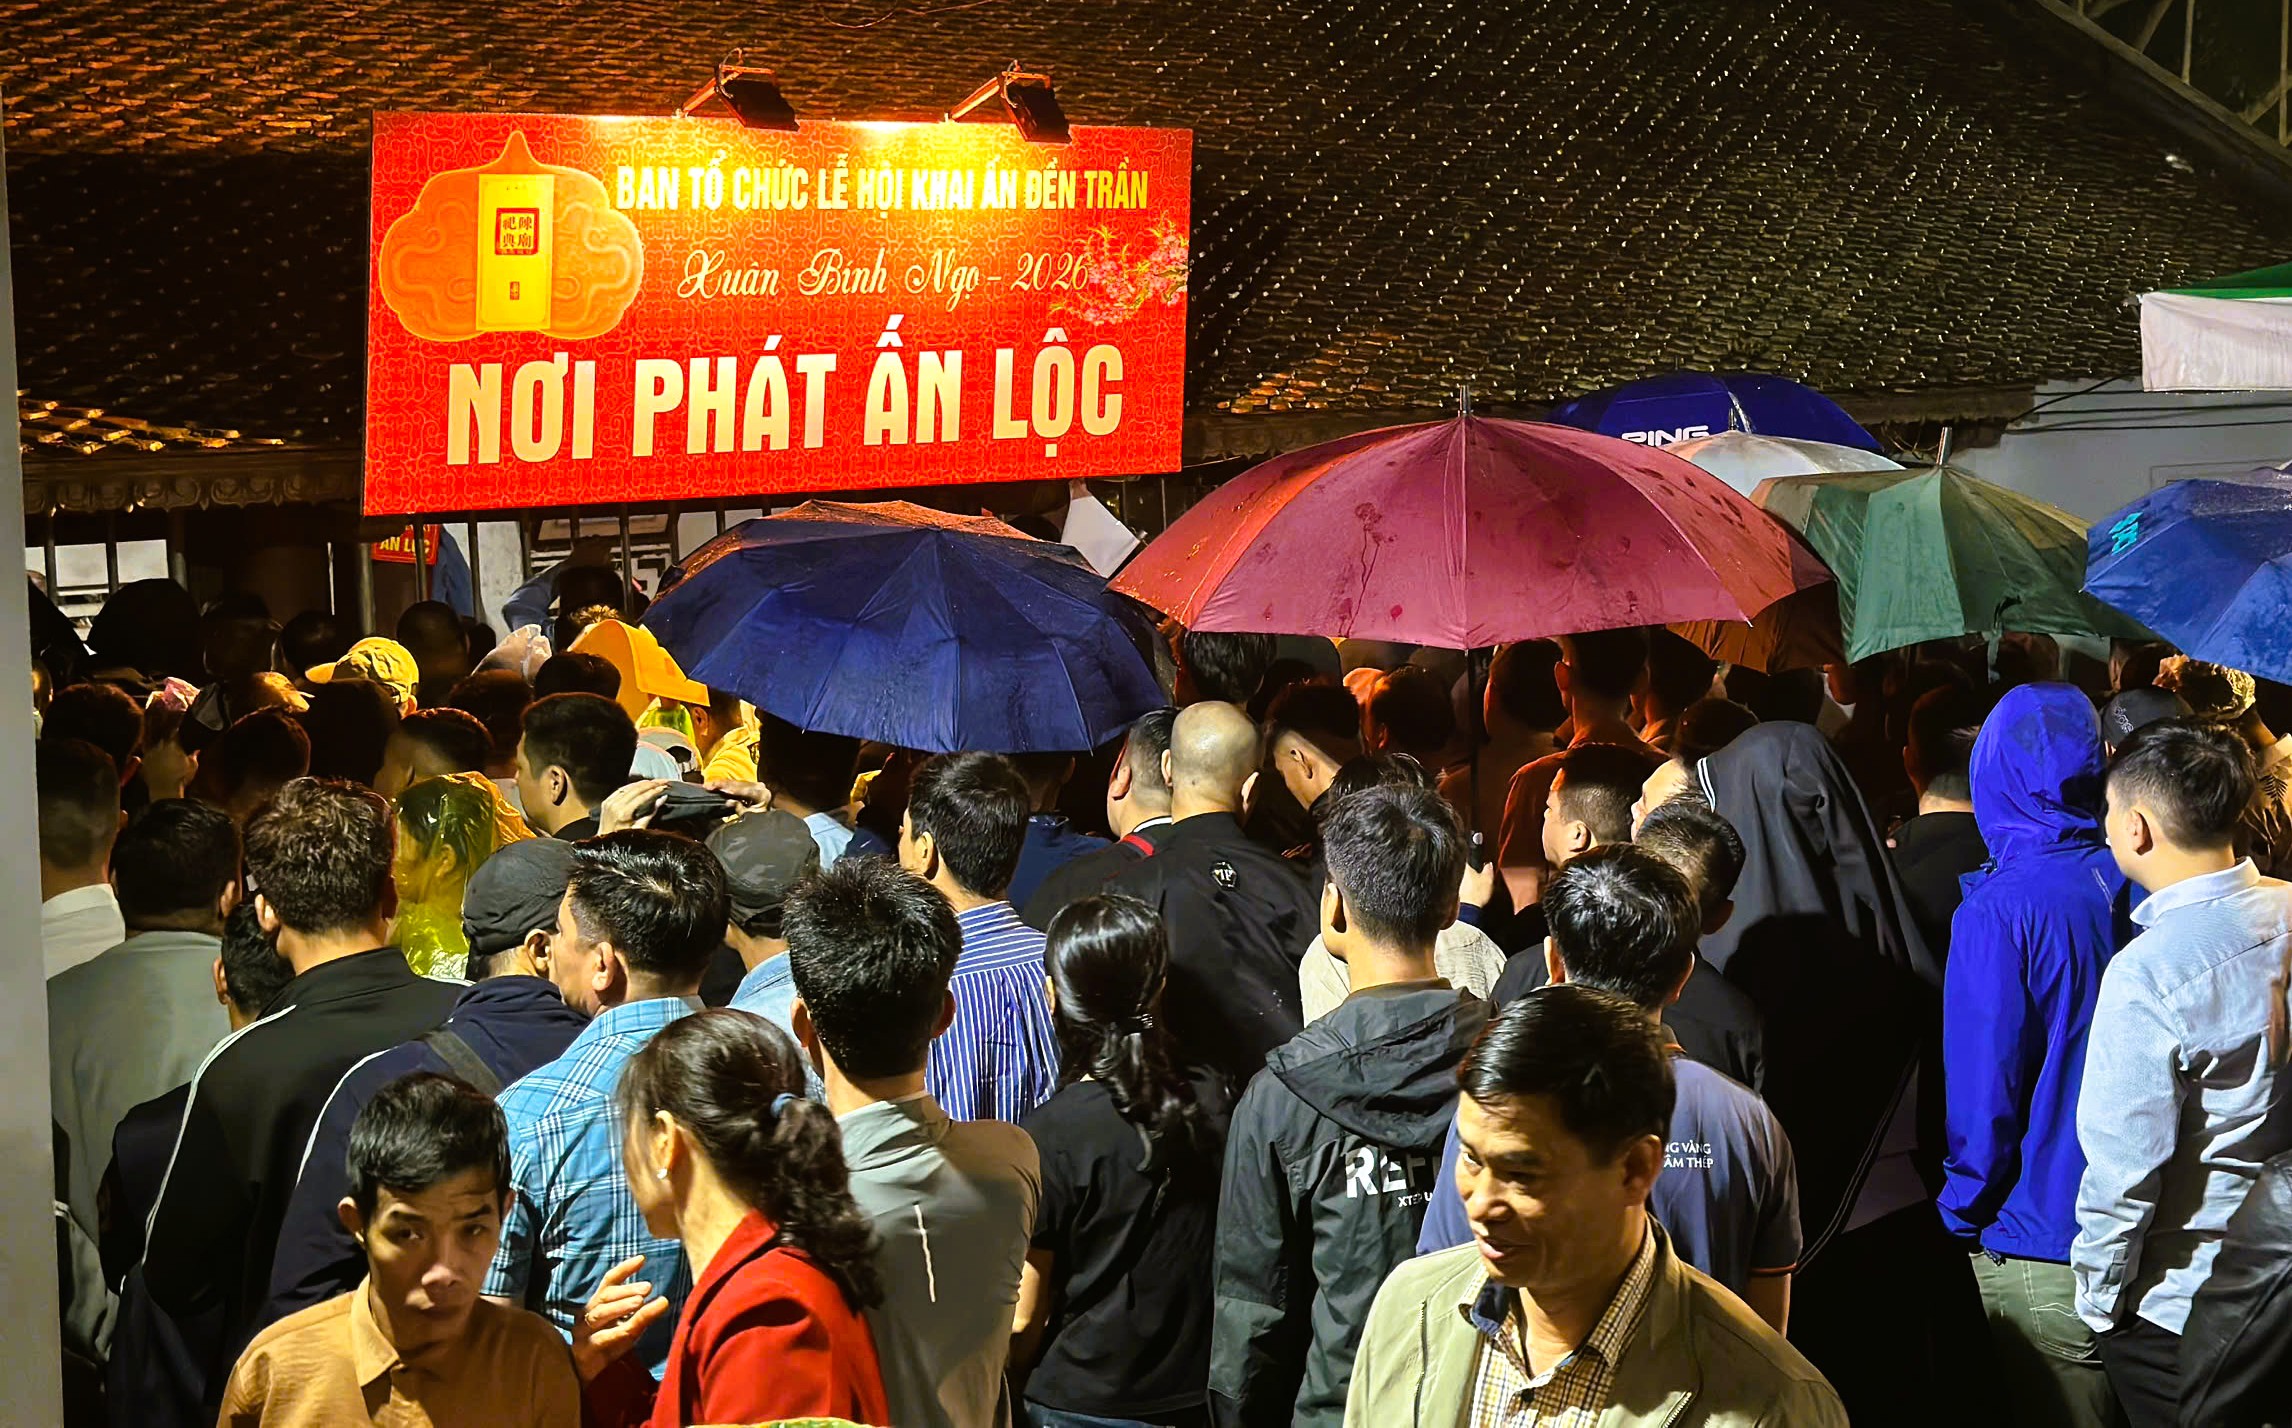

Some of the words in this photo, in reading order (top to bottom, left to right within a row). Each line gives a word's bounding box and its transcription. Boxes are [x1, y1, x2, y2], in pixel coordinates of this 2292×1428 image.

[617, 165, 680, 210] BAN
[688, 149, 725, 210] TỔ
[733, 158, 809, 211] CHỨC
[818, 152, 849, 210] LỄ
[857, 160, 902, 219] HỘI
[911, 168, 974, 211] KHAI
[980, 155, 1017, 210] ẤN
[1024, 156, 1077, 210] ĐỀN
[1084, 156, 1149, 210] TRẦN
[676, 249, 780, 299] Xuân
[797, 247, 888, 296] Bính
[904, 248, 980, 312] Ngọ
[1010, 252, 1090, 291] 2026
[446, 351, 597, 466] NƠI
[632, 334, 838, 458] PHÁT
[863, 314, 963, 447] ẤN
[992, 327, 1125, 458] LỘC
[1621, 425, 1710, 448] PING
[1681, 1139, 1712, 1155] VÀNG
[1686, 1155, 1714, 1169] THÉP
